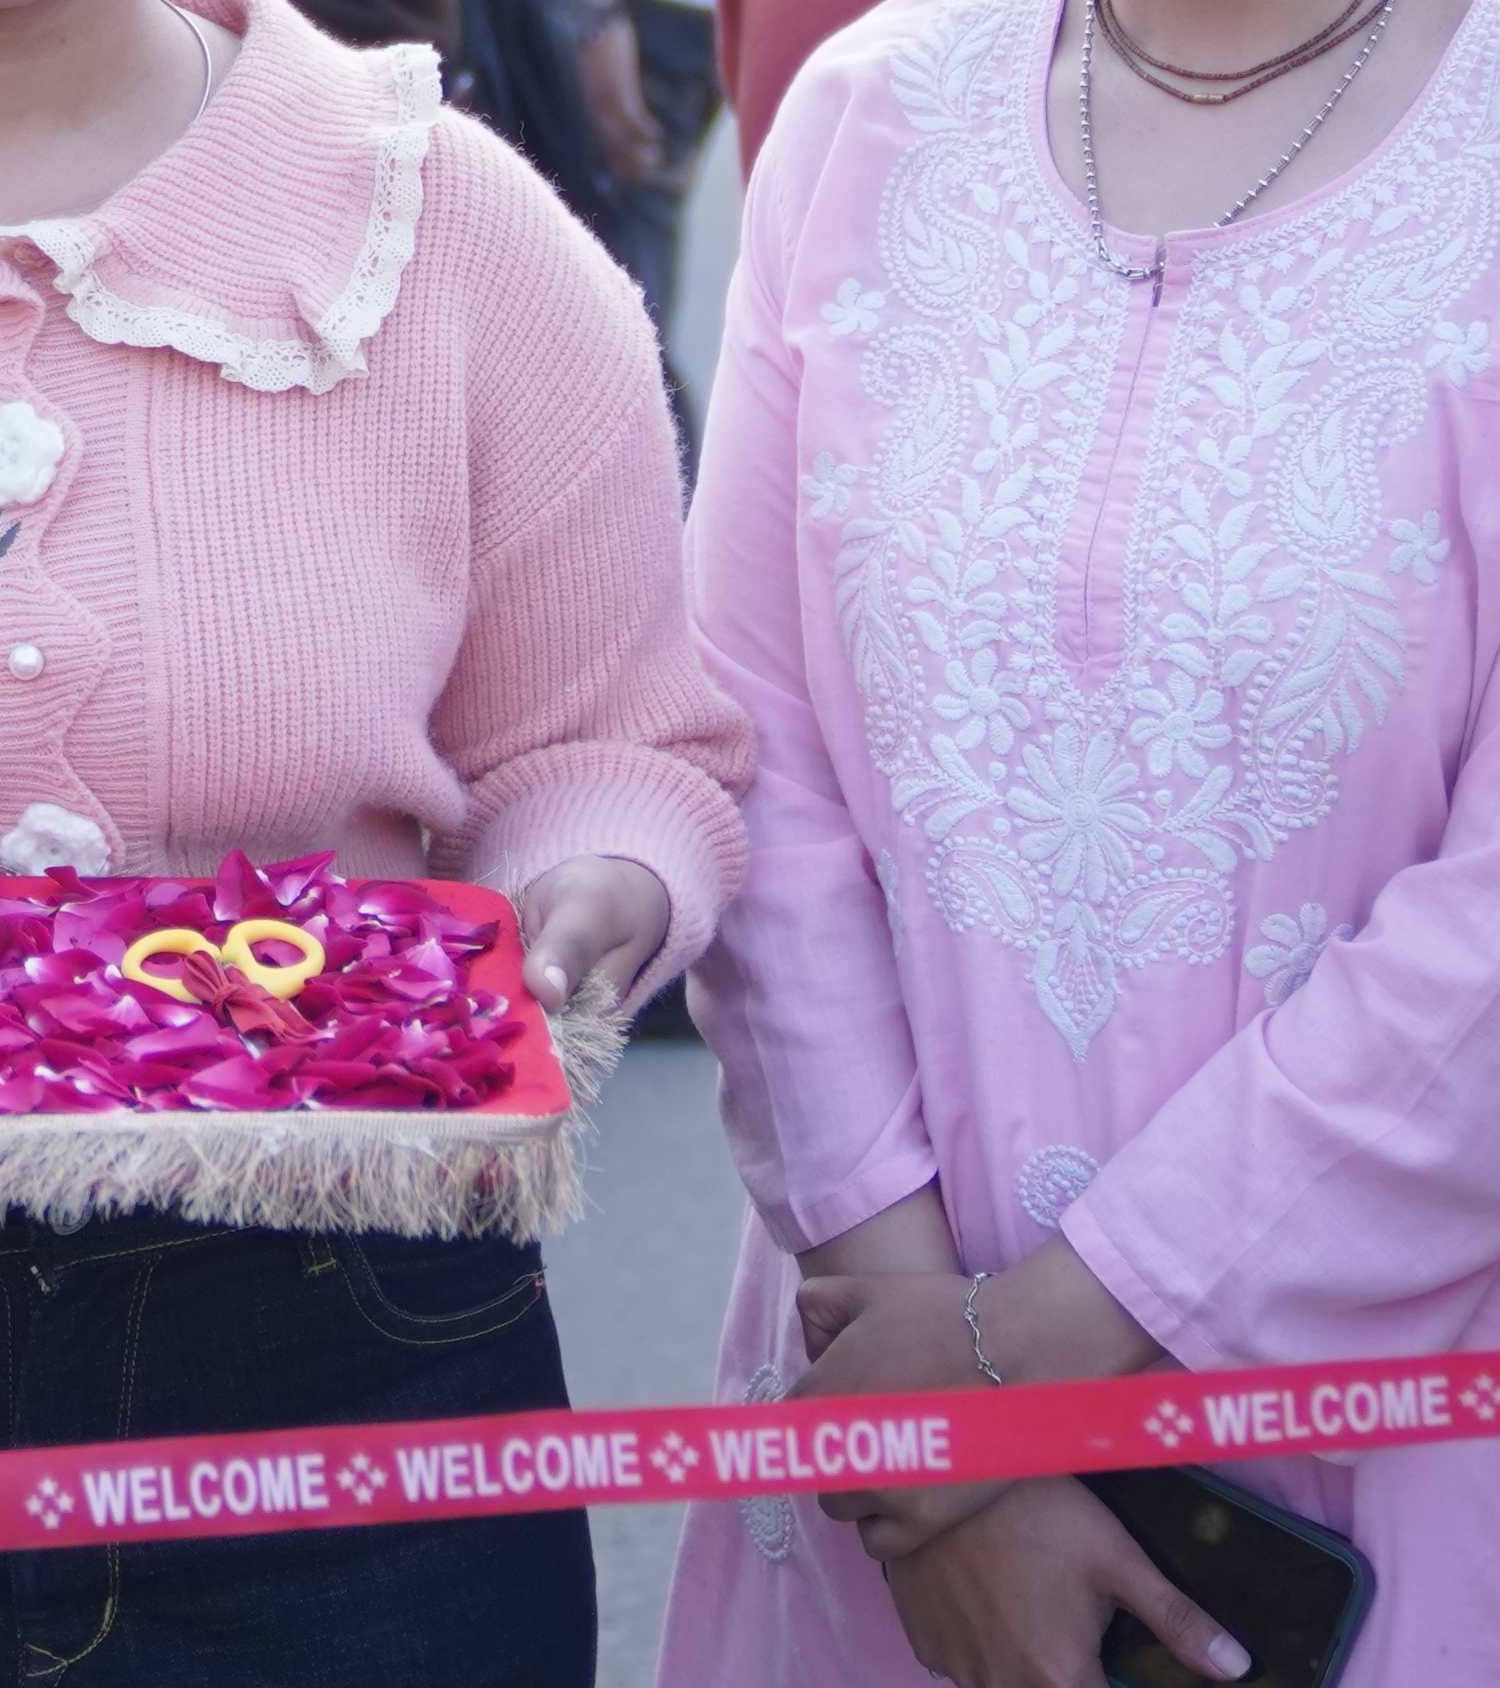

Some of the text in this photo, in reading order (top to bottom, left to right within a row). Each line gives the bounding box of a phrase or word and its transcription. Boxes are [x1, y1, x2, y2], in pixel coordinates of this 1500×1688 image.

[82, 1453, 330, 1526] WELCOME
[396, 1432, 642, 1502] WELCOME
[709, 1418, 952, 1481] WELCOME
[1203, 1375, 1451, 1444] WELCOME
